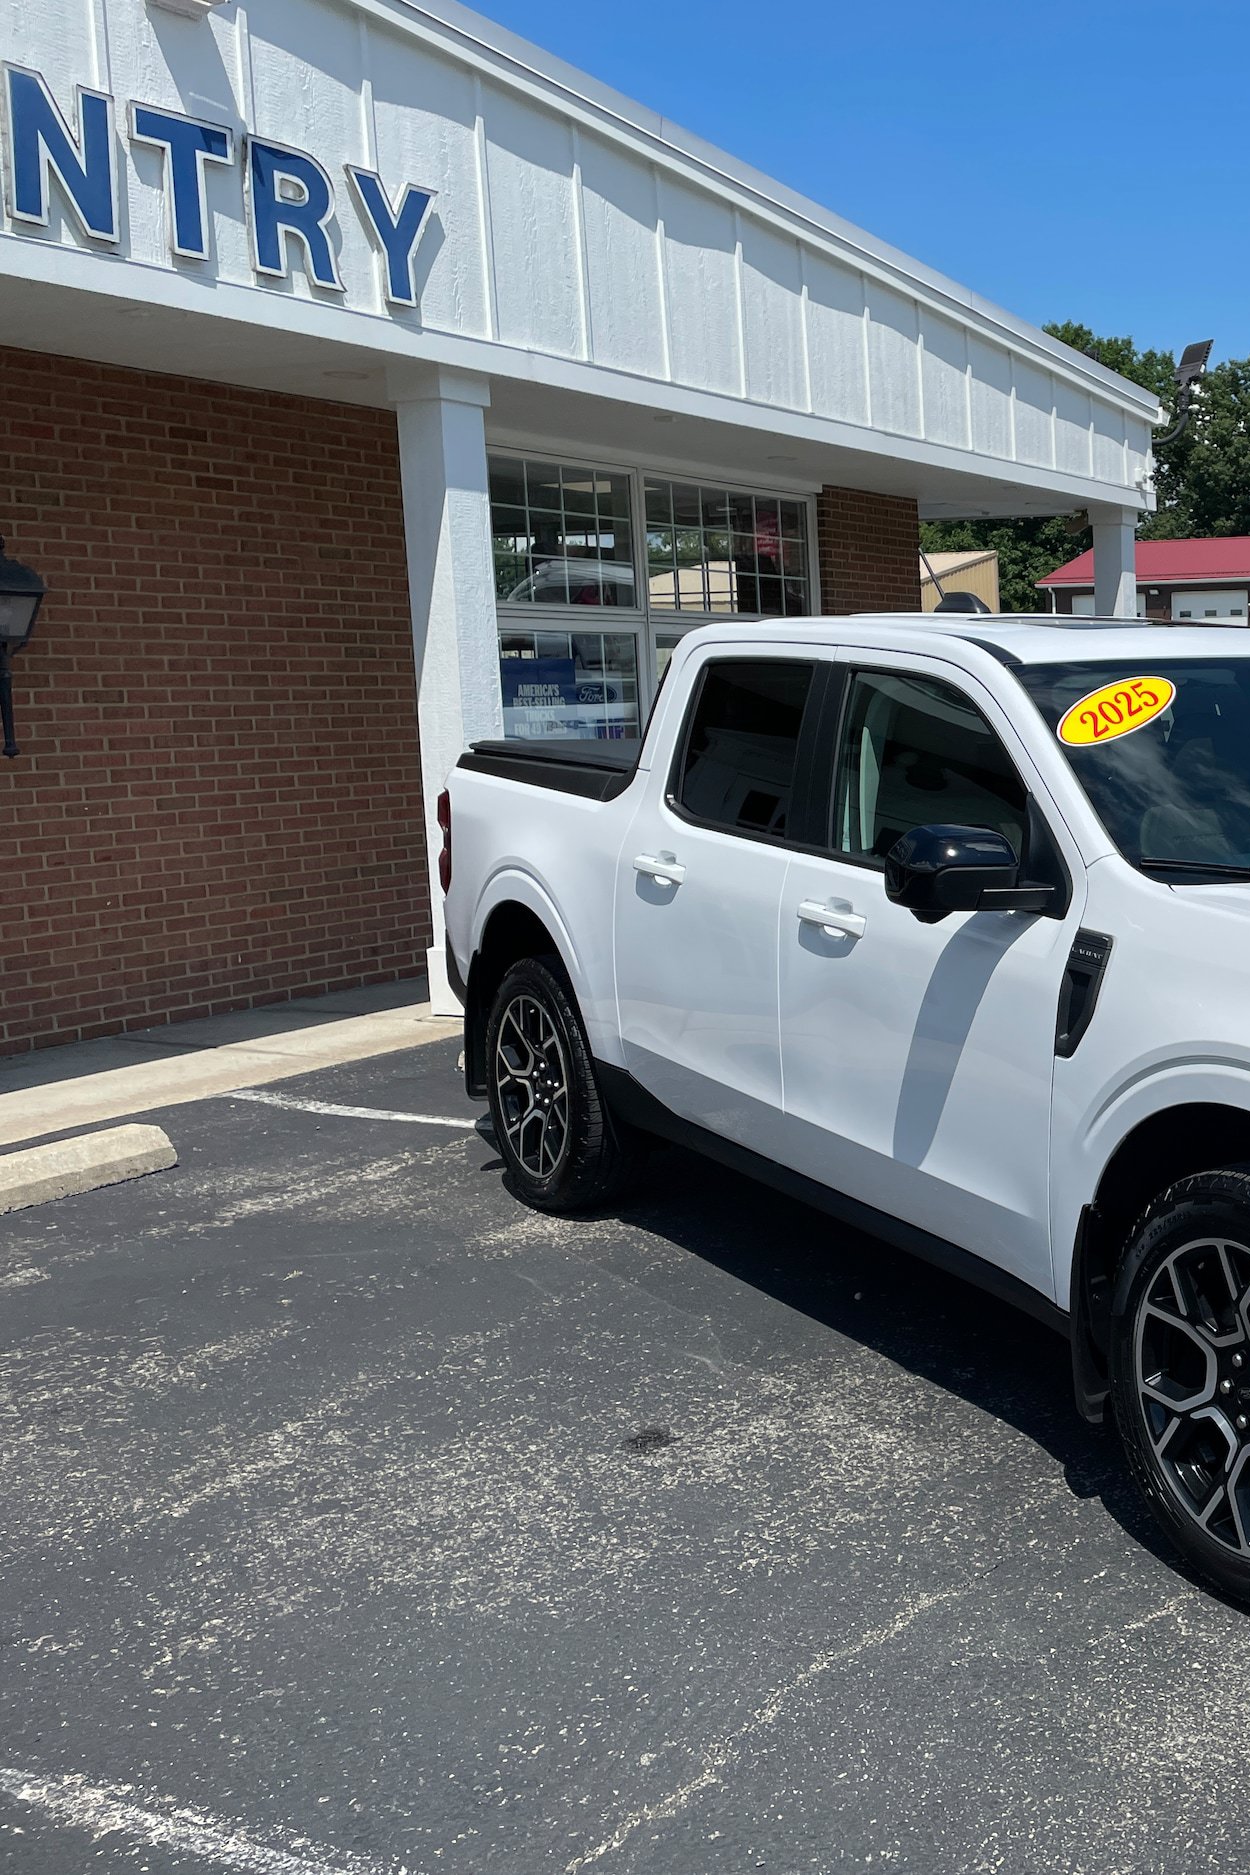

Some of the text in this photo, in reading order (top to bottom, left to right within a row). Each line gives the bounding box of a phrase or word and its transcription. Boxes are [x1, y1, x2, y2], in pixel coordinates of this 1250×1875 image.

[2, 60, 438, 308] NTRY
[518, 684, 560, 697] AMERICA'S
[513, 697, 566, 710] BEST-SELLING
[1080, 682, 1159, 738] 2025
[525, 710, 555, 722] TRUCKS
[514, 723, 531, 736] FOR
